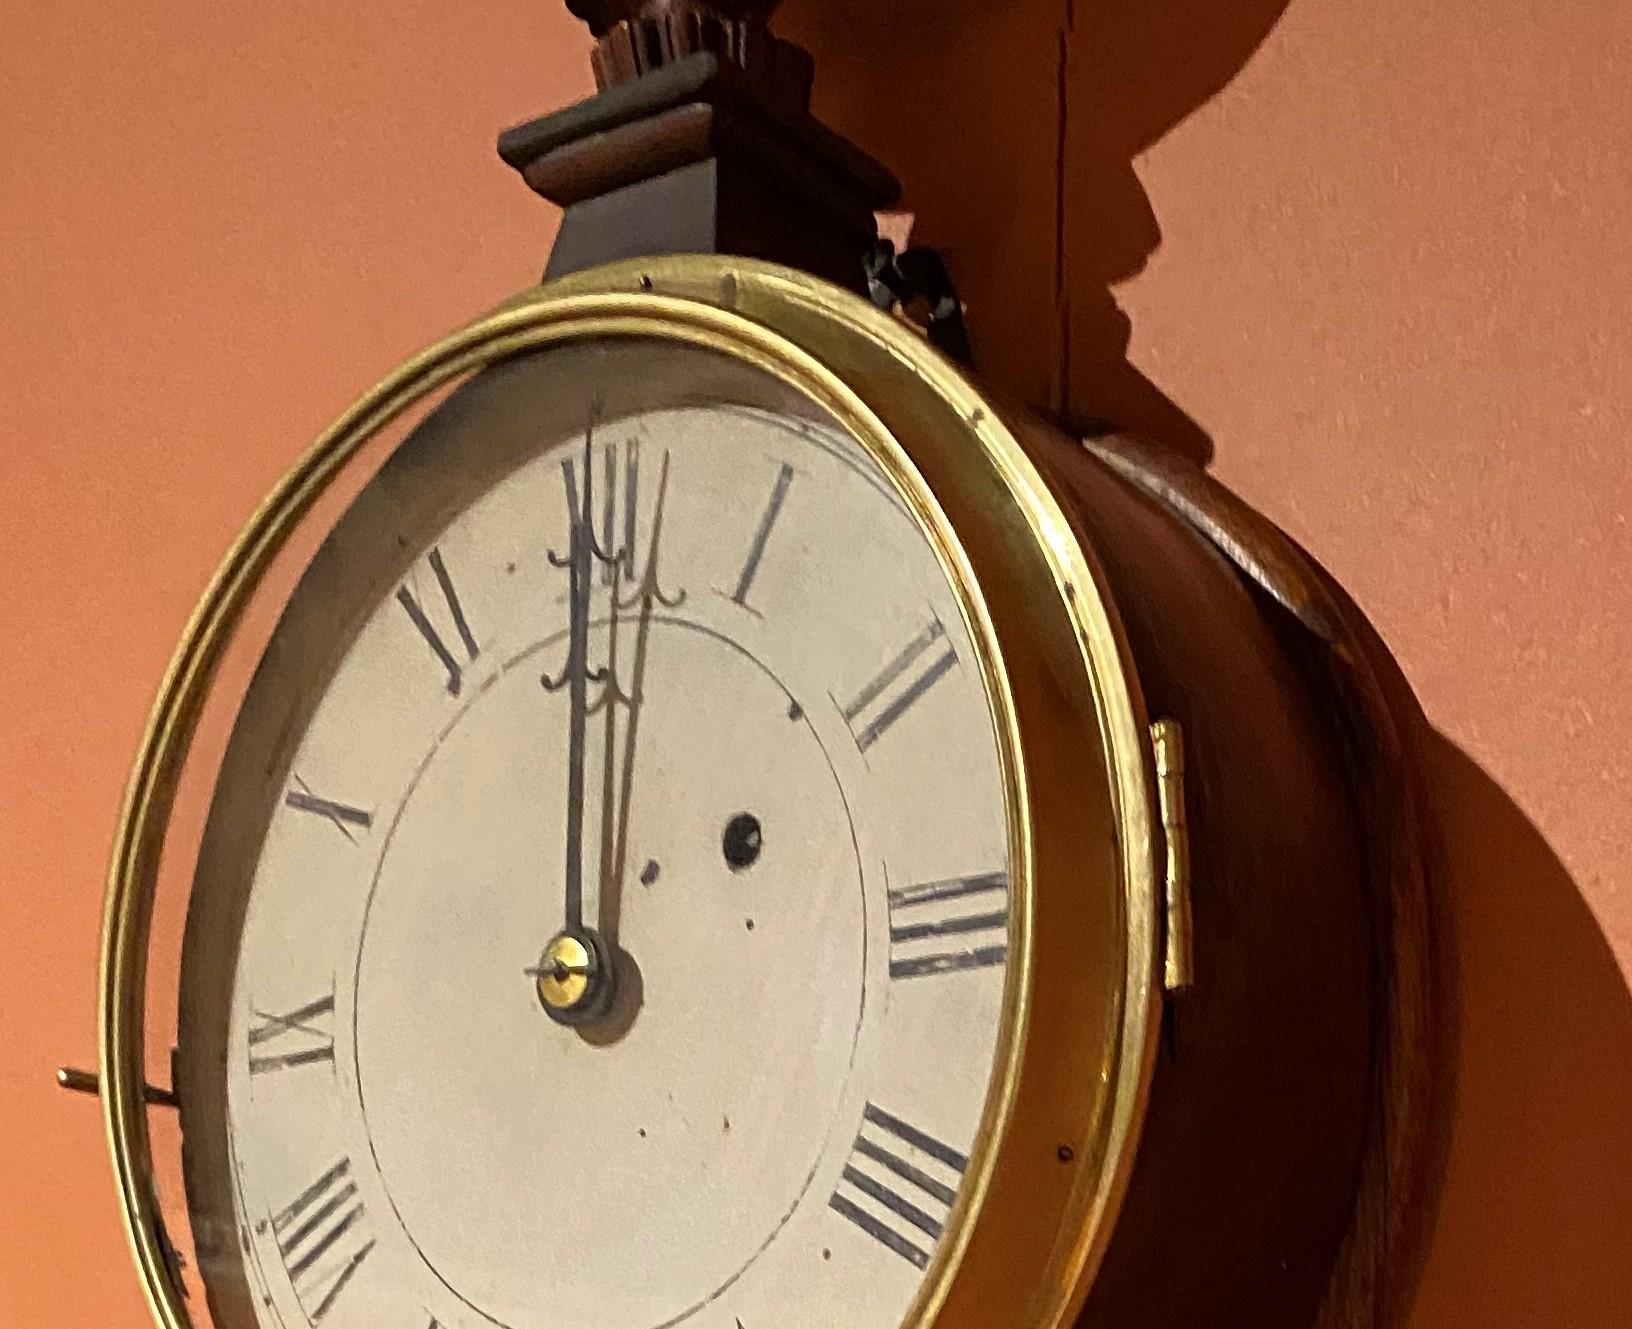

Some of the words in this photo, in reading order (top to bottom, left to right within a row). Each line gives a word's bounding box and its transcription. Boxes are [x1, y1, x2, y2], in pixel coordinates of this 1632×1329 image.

[716, 462, 792, 618] I
[829, 604, 960, 768] II
[285, 773, 371, 847] X
[884, 866, 1006, 982] III
[248, 985, 336, 1077] IX
[828, 1101, 969, 1271] IIII
